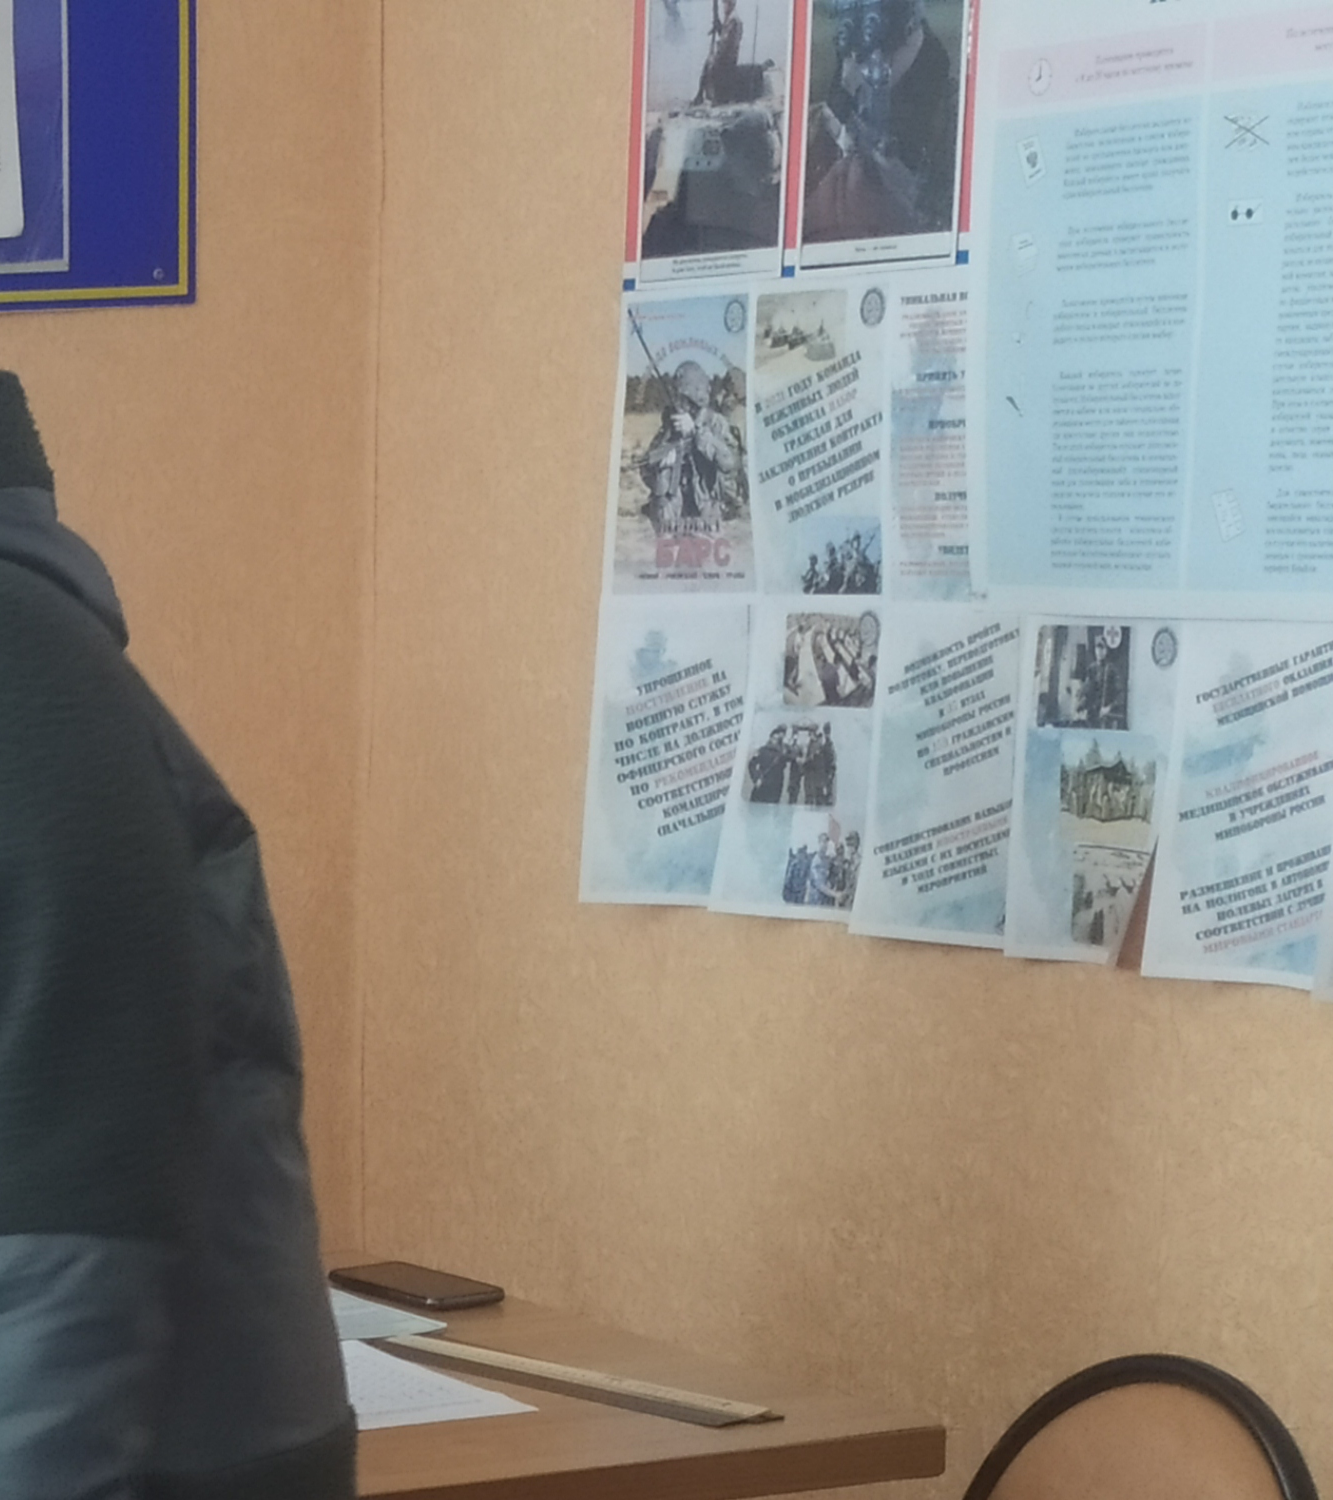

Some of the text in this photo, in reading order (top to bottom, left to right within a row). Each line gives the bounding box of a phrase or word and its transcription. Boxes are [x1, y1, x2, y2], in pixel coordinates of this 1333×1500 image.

[816, 350, 861, 383] КОМАНДА
[656, 538, 731, 568] БАРС
[625, 684, 732, 733] ВОЕННУЮ СЛУЖБУ
[614, 739, 635, 752] ПО
[614, 746, 661, 768] ЧИСЛЕ
[664, 742, 681, 756] НА
[617, 730, 741, 784] ОФИЦЕРСКОГО СОСТА
[629, 782, 649, 796] ПО
[1182, 902, 1201, 915] НА
